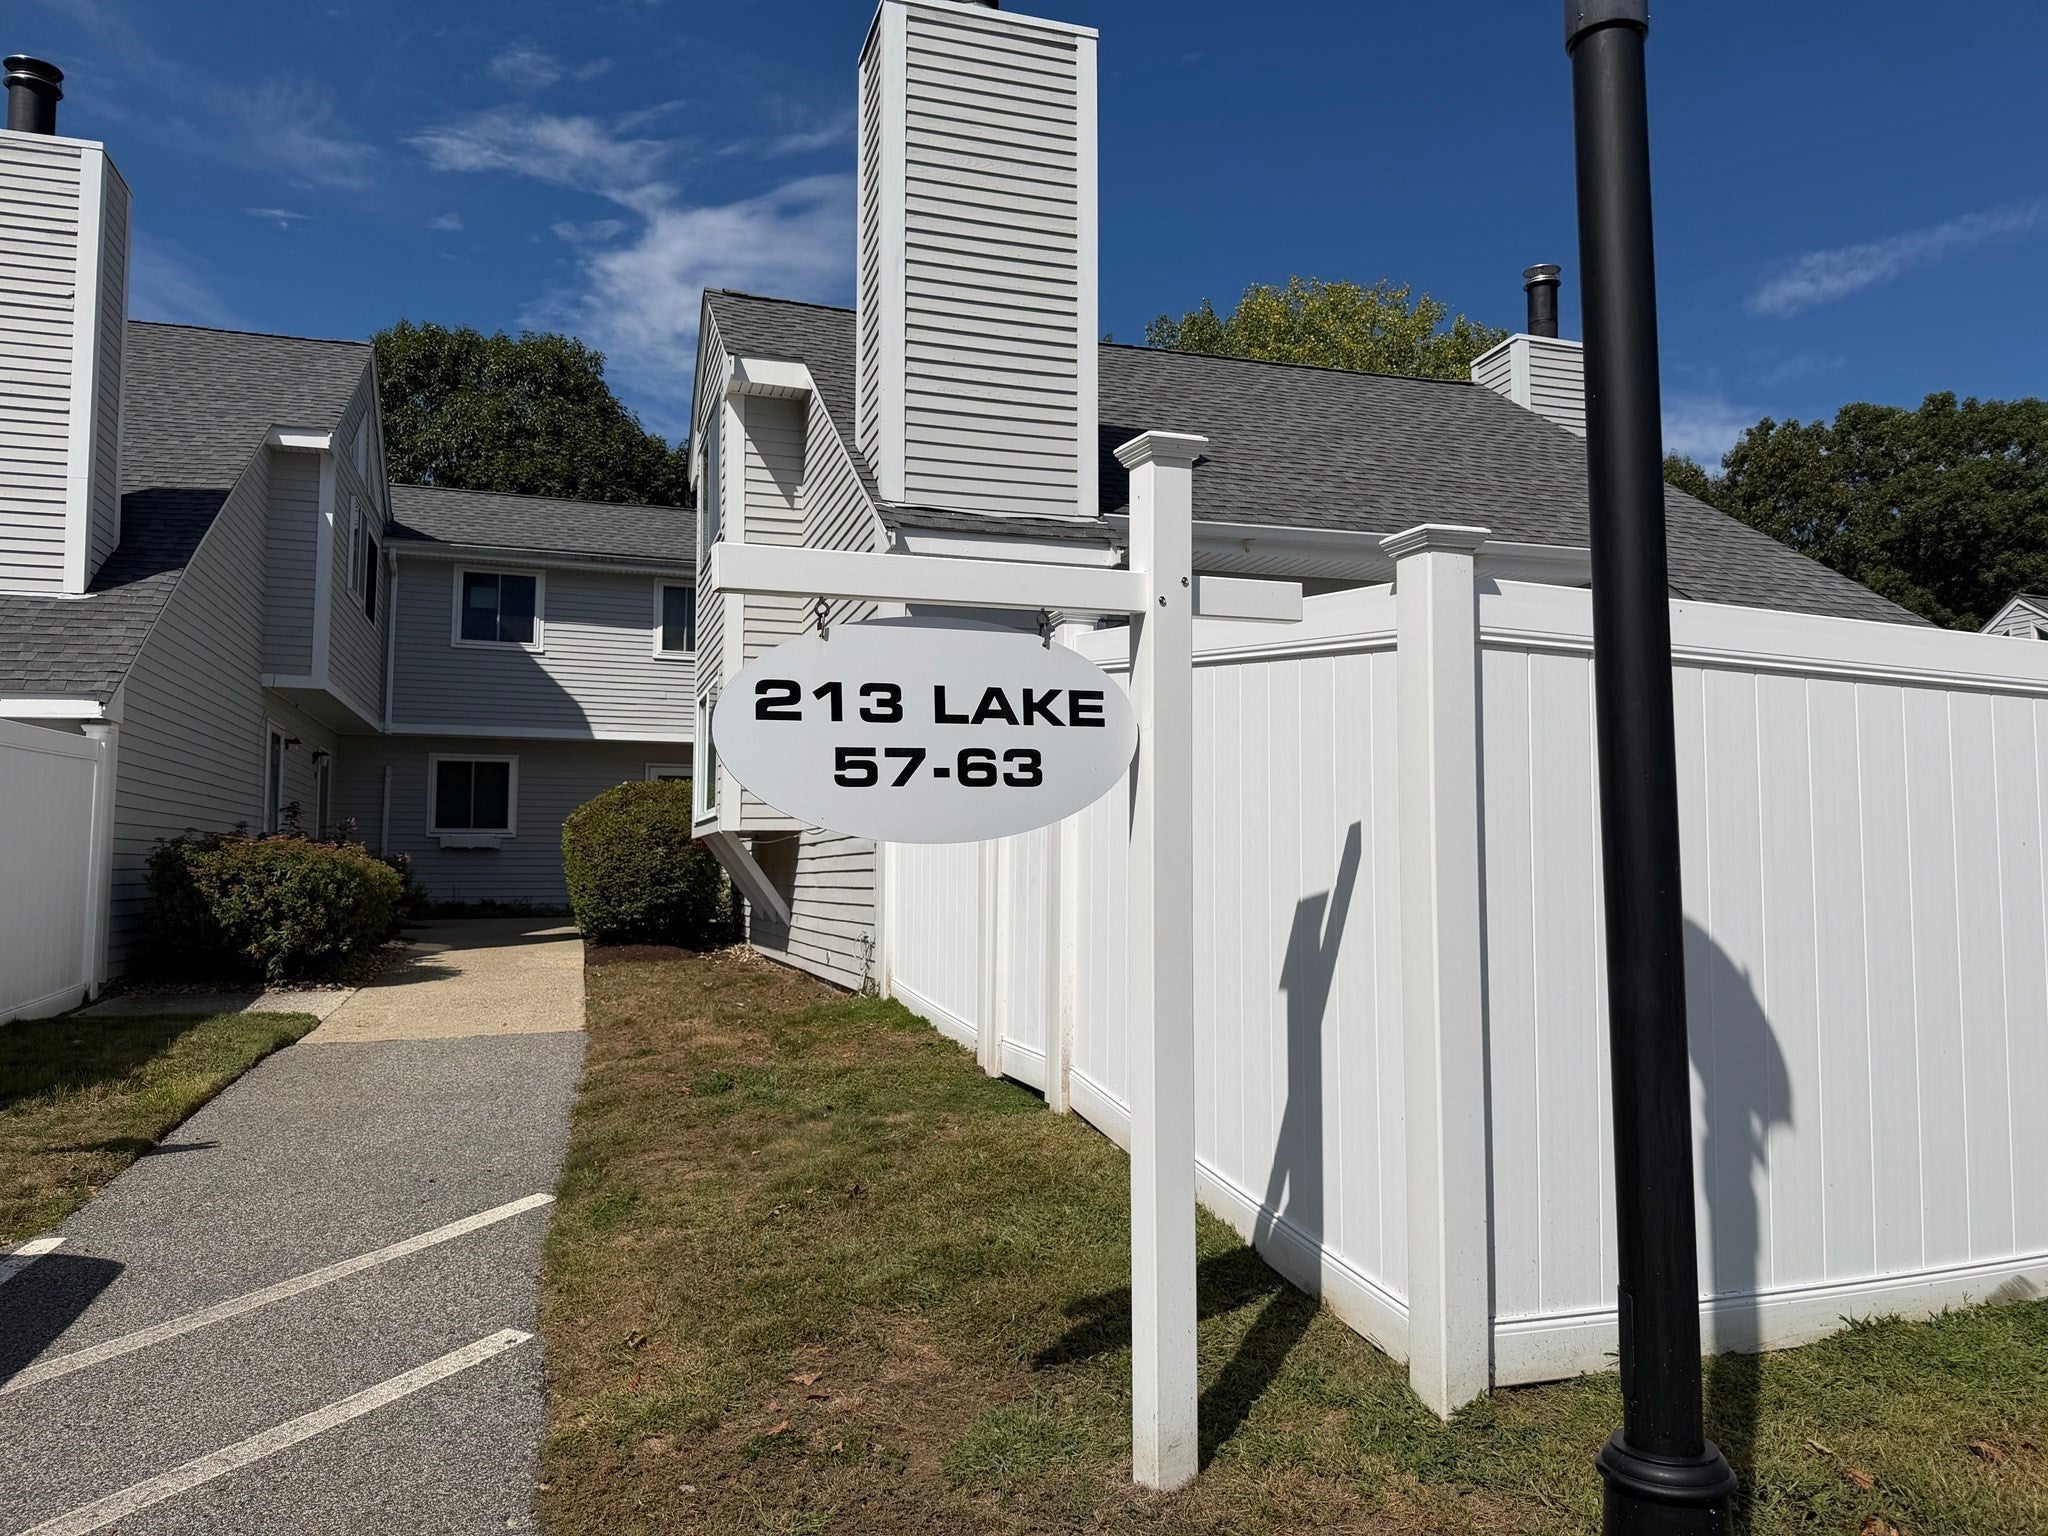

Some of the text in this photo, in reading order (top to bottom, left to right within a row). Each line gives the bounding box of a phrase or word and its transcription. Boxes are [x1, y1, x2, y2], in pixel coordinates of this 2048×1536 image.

[754, 679, 1107, 728] 213 LAKE
[833, 746, 1044, 789] 57-63
